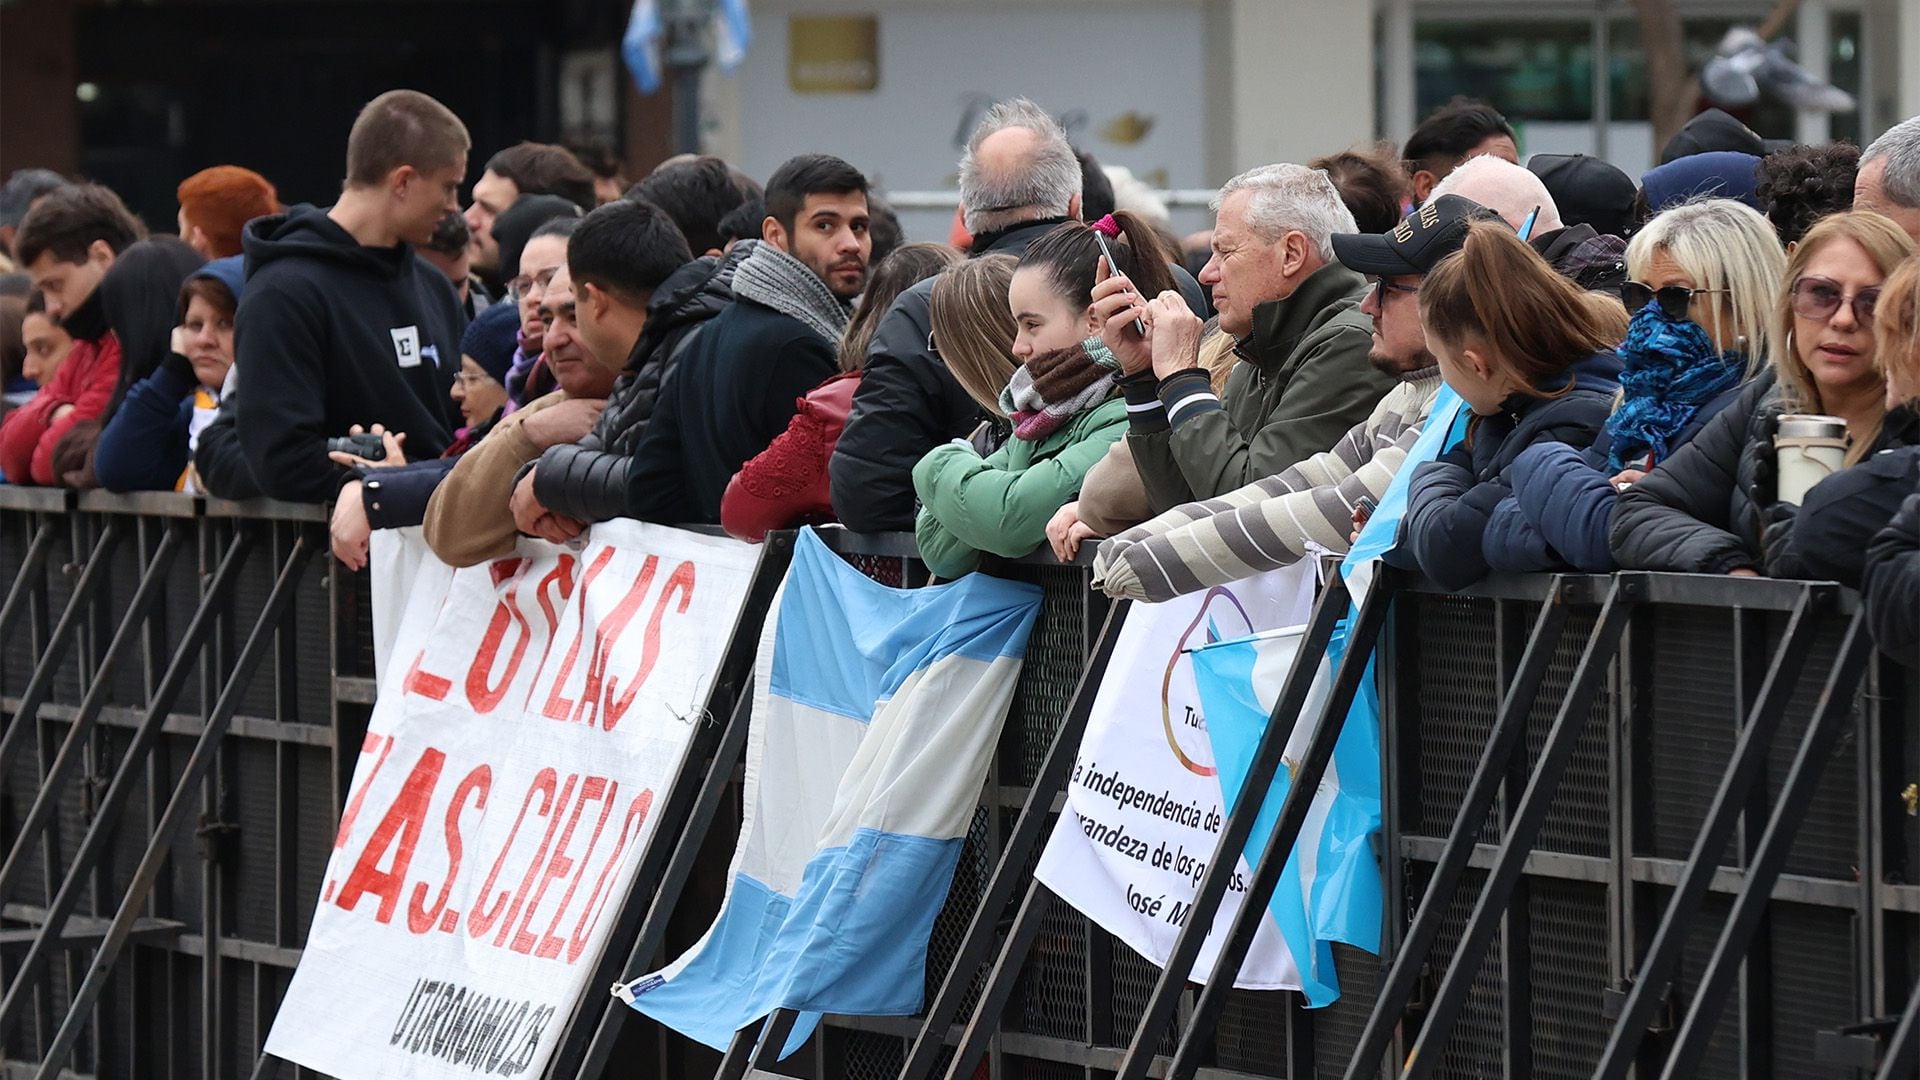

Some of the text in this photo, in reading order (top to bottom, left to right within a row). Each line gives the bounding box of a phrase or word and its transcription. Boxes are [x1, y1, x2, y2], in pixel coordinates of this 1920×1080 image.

[1083, 762, 1201, 829] independencia
[1204, 805, 1221, 834] de
[1076, 812, 1149, 862] randeza
[1151, 841, 1173, 871] de
[1173, 845, 1196, 876] los
